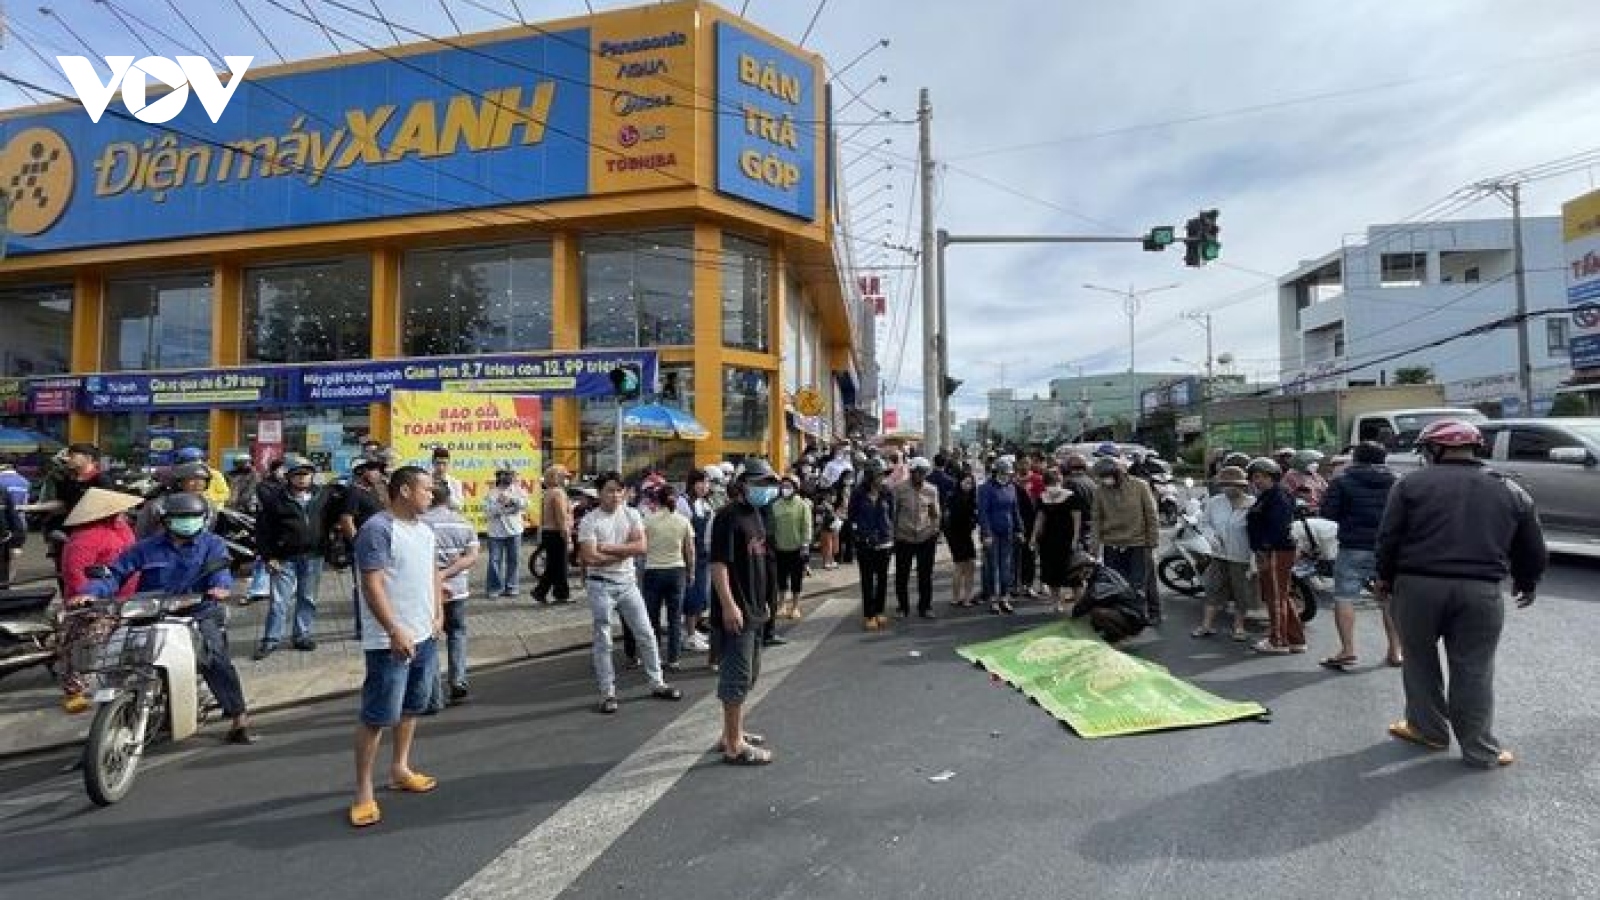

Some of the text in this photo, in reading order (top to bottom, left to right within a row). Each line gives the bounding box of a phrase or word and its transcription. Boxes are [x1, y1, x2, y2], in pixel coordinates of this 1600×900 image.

[599, 32, 686, 57] Panasonic
[738, 54, 799, 105] BÁN
[334, 80, 556, 170] XANH
[743, 103, 798, 150] TRẢ
[605, 153, 677, 172] TOSHIBA
